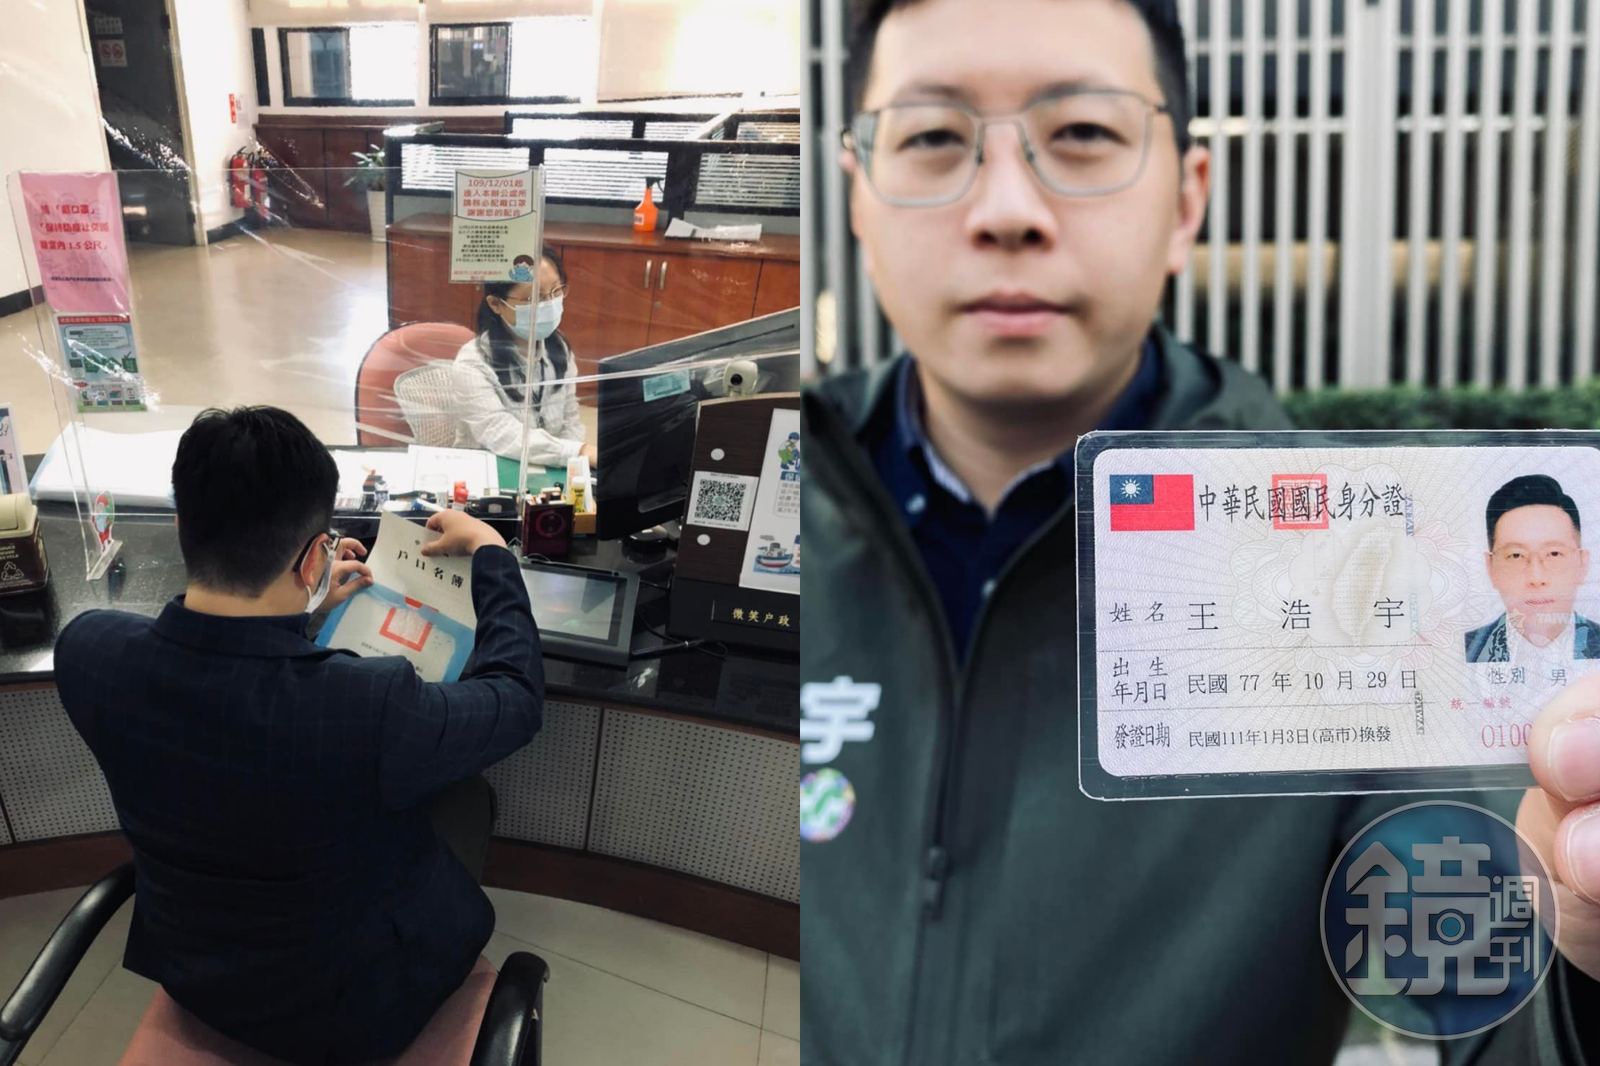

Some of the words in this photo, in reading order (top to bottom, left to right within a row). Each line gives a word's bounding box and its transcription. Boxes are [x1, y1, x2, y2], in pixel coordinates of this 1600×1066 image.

[468, 179, 523, 187] 109/12/01起
[1198, 481, 1406, 523] 中華民國國民身分證
[1488, 666, 1525, 685] 性別
[1550, 668, 1567, 687] 男
[1111, 681, 1167, 705] 年月日
[1451, 696, 1512, 711] 統一編號
[800, 676, 882, 764] 宇
[1113, 722, 1171, 750] 發證日期
[1188, 724, 1391, 749] 民國111年1月3日(高市)換發
